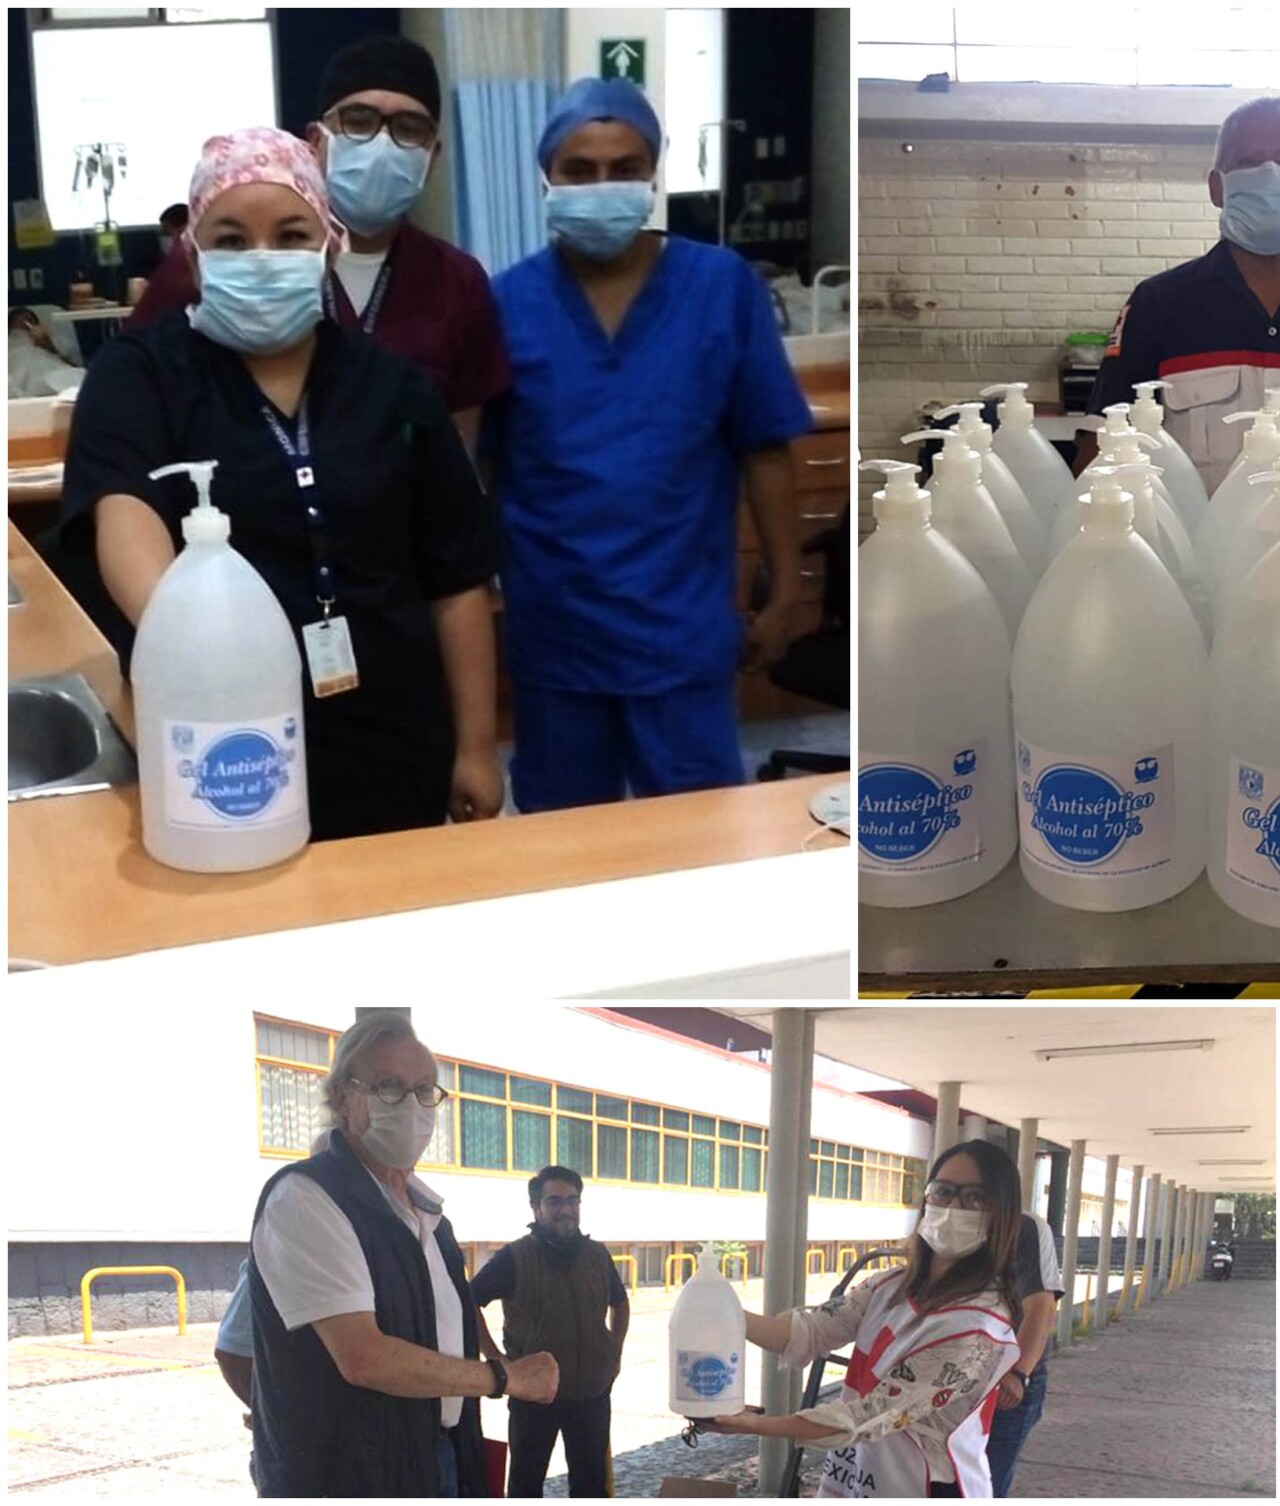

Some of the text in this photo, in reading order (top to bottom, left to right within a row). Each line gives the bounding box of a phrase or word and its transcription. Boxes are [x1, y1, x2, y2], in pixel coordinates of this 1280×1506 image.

[858, 785, 972, 816] Antiséptico
[1022, 781, 1154, 820] Gel Antiséptico
[899, 820, 916, 835] al
[922, 809, 961, 833] 70%
[1032, 814, 1142, 839] Alcohol al 70%
[1243, 807, 1278, 832] Gel
